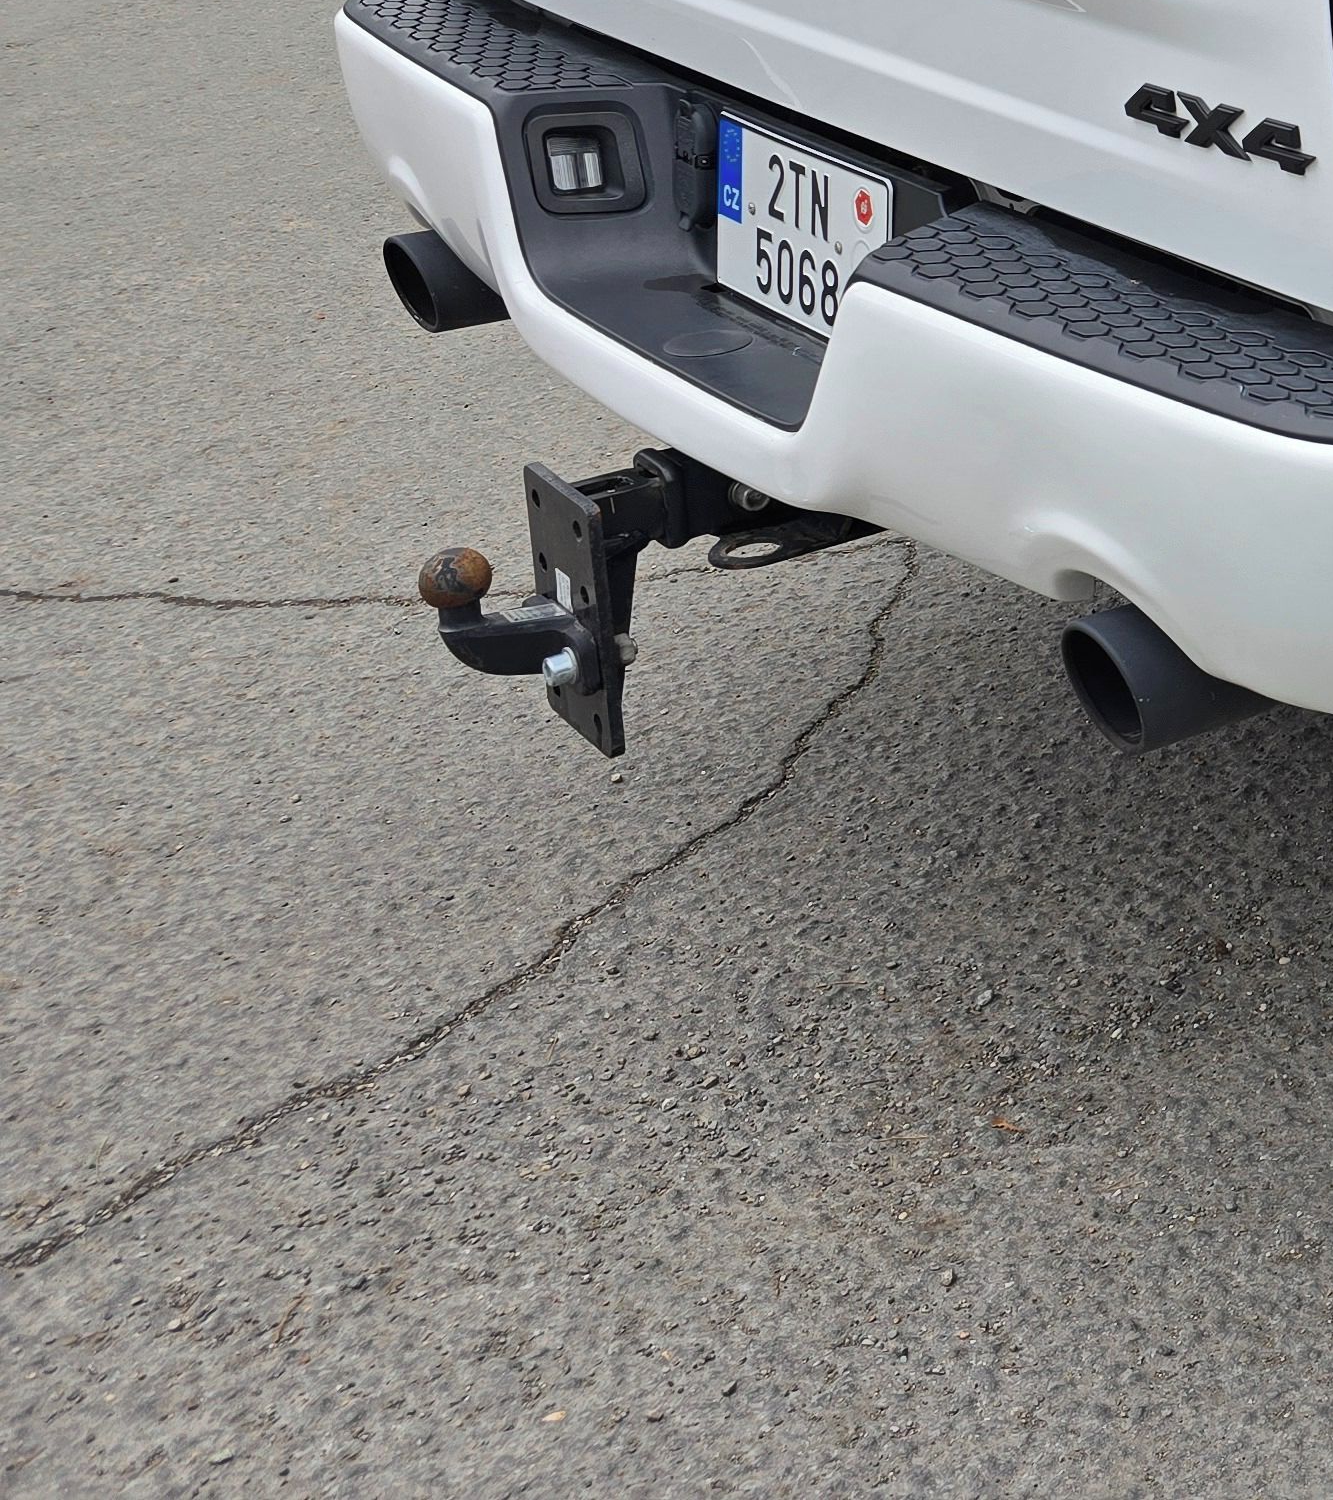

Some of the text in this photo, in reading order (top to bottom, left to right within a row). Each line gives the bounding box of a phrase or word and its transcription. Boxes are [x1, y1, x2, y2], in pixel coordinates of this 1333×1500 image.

[723, 184, 740, 211] CZ
[768, 153, 829, 242] 2TN
[756, 227, 839, 327] 5068
